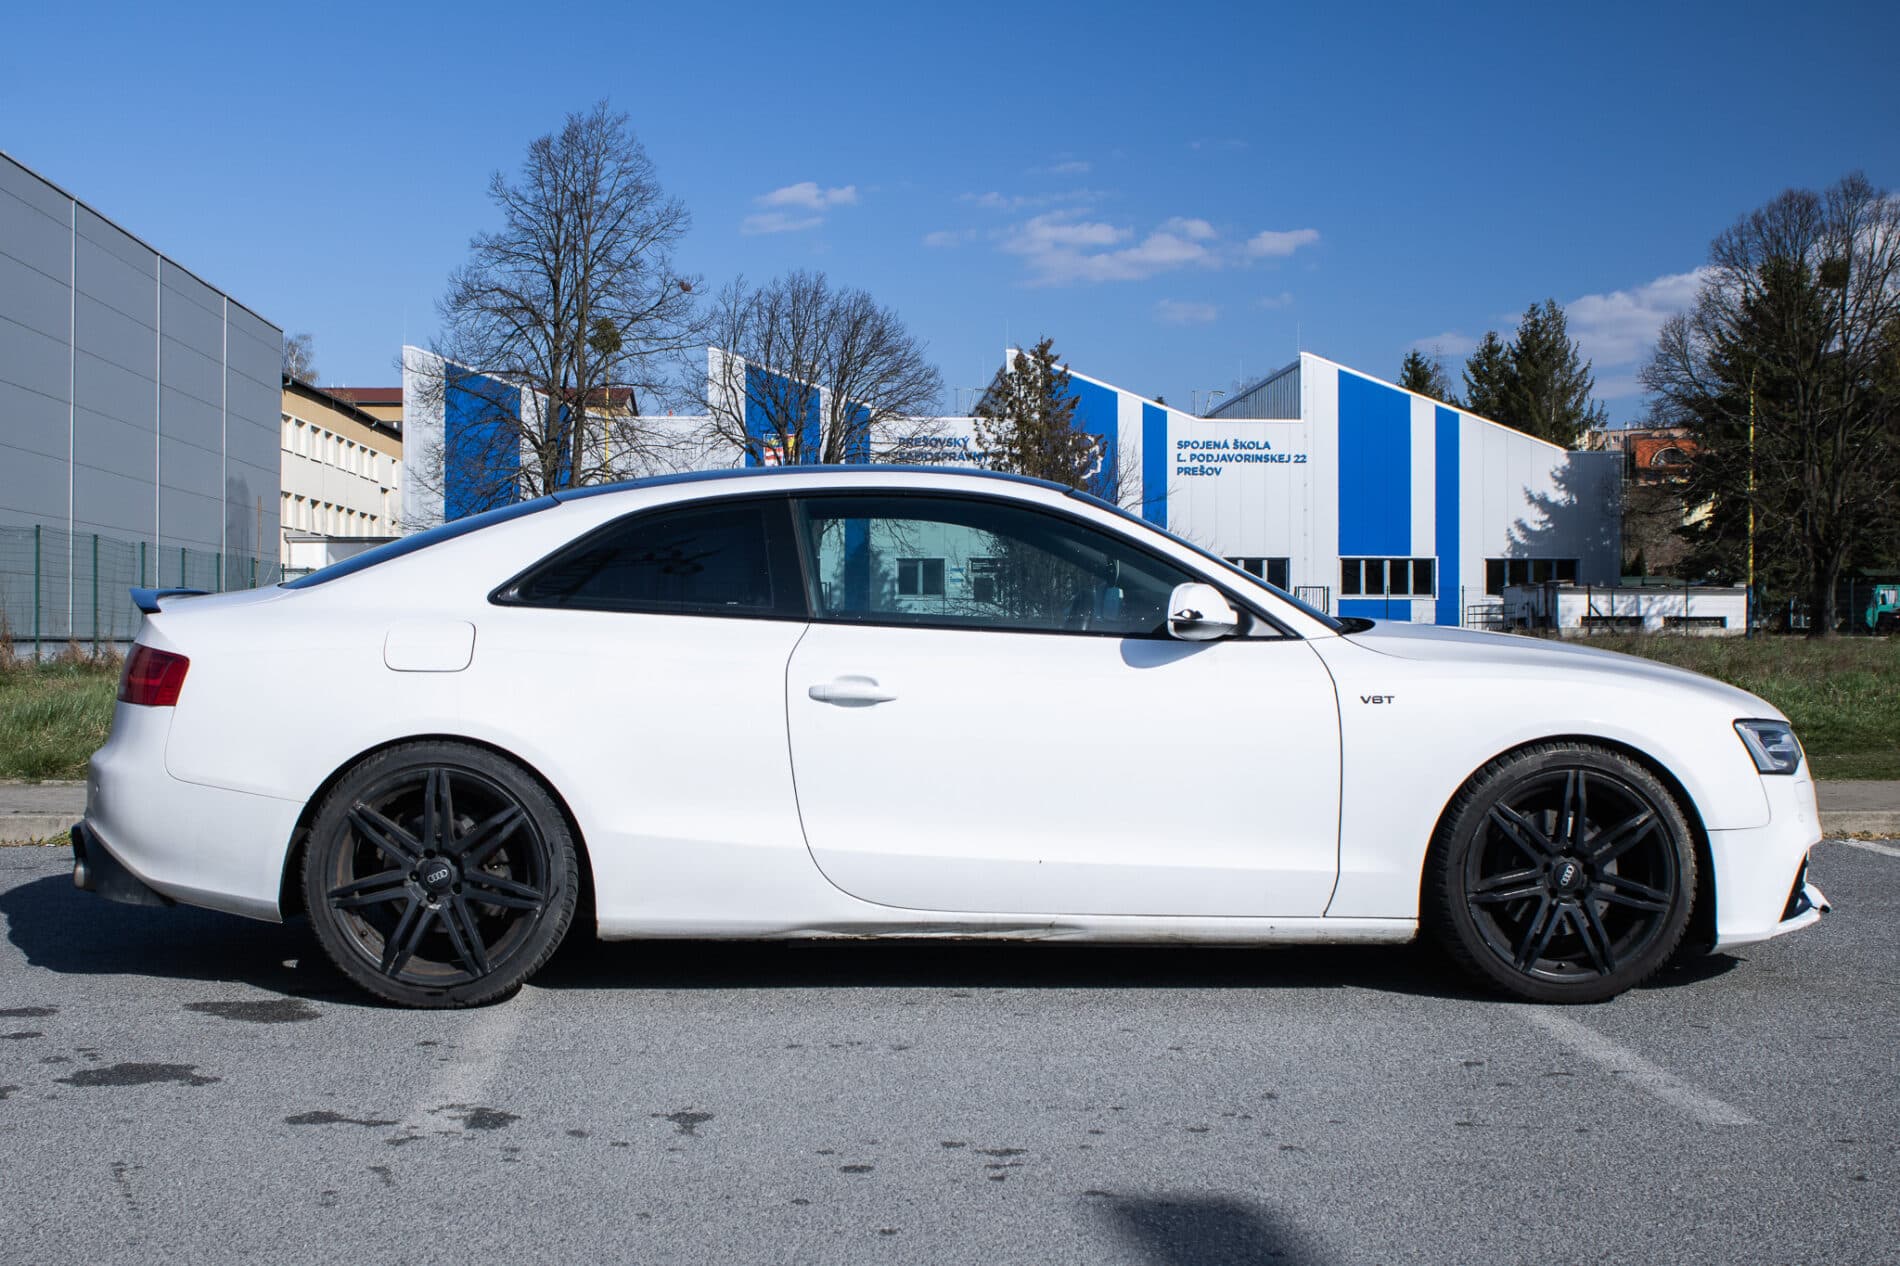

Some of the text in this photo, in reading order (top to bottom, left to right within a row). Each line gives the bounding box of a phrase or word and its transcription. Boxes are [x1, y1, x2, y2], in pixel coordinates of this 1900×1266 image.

[1176, 438, 1271, 450] SPOJENÁ ŠKOLA
[1190, 453, 1291, 464] PODJAVORINSKEJ
[1293, 454, 1307, 464] 22
[1176, 465, 1223, 476] PREŠOV
